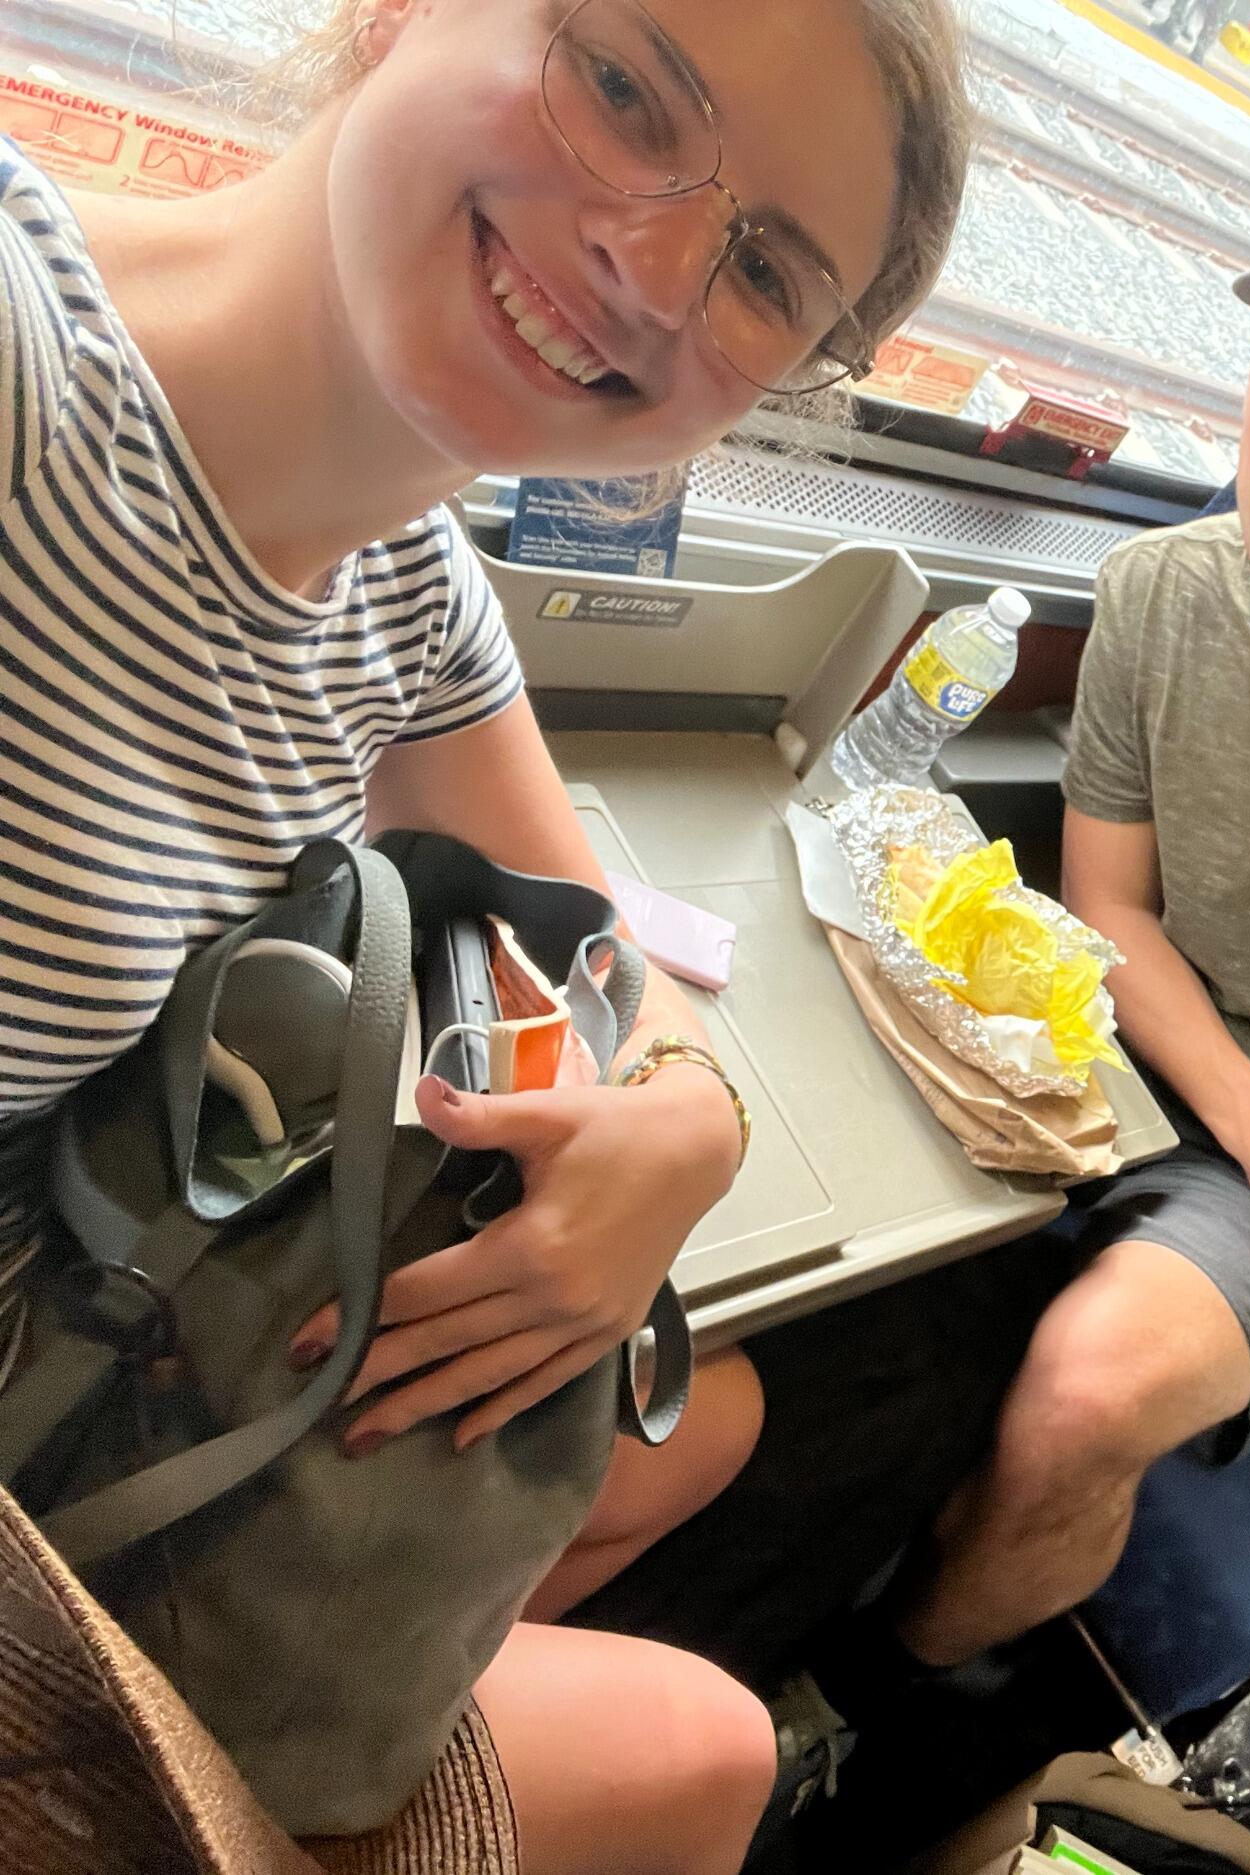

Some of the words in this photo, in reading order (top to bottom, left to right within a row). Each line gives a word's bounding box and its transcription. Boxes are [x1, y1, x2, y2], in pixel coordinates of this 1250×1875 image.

[135, 114, 218, 147] Window
[119, 174, 131, 187] 2
[590, 596, 681, 613] CAUTION!
